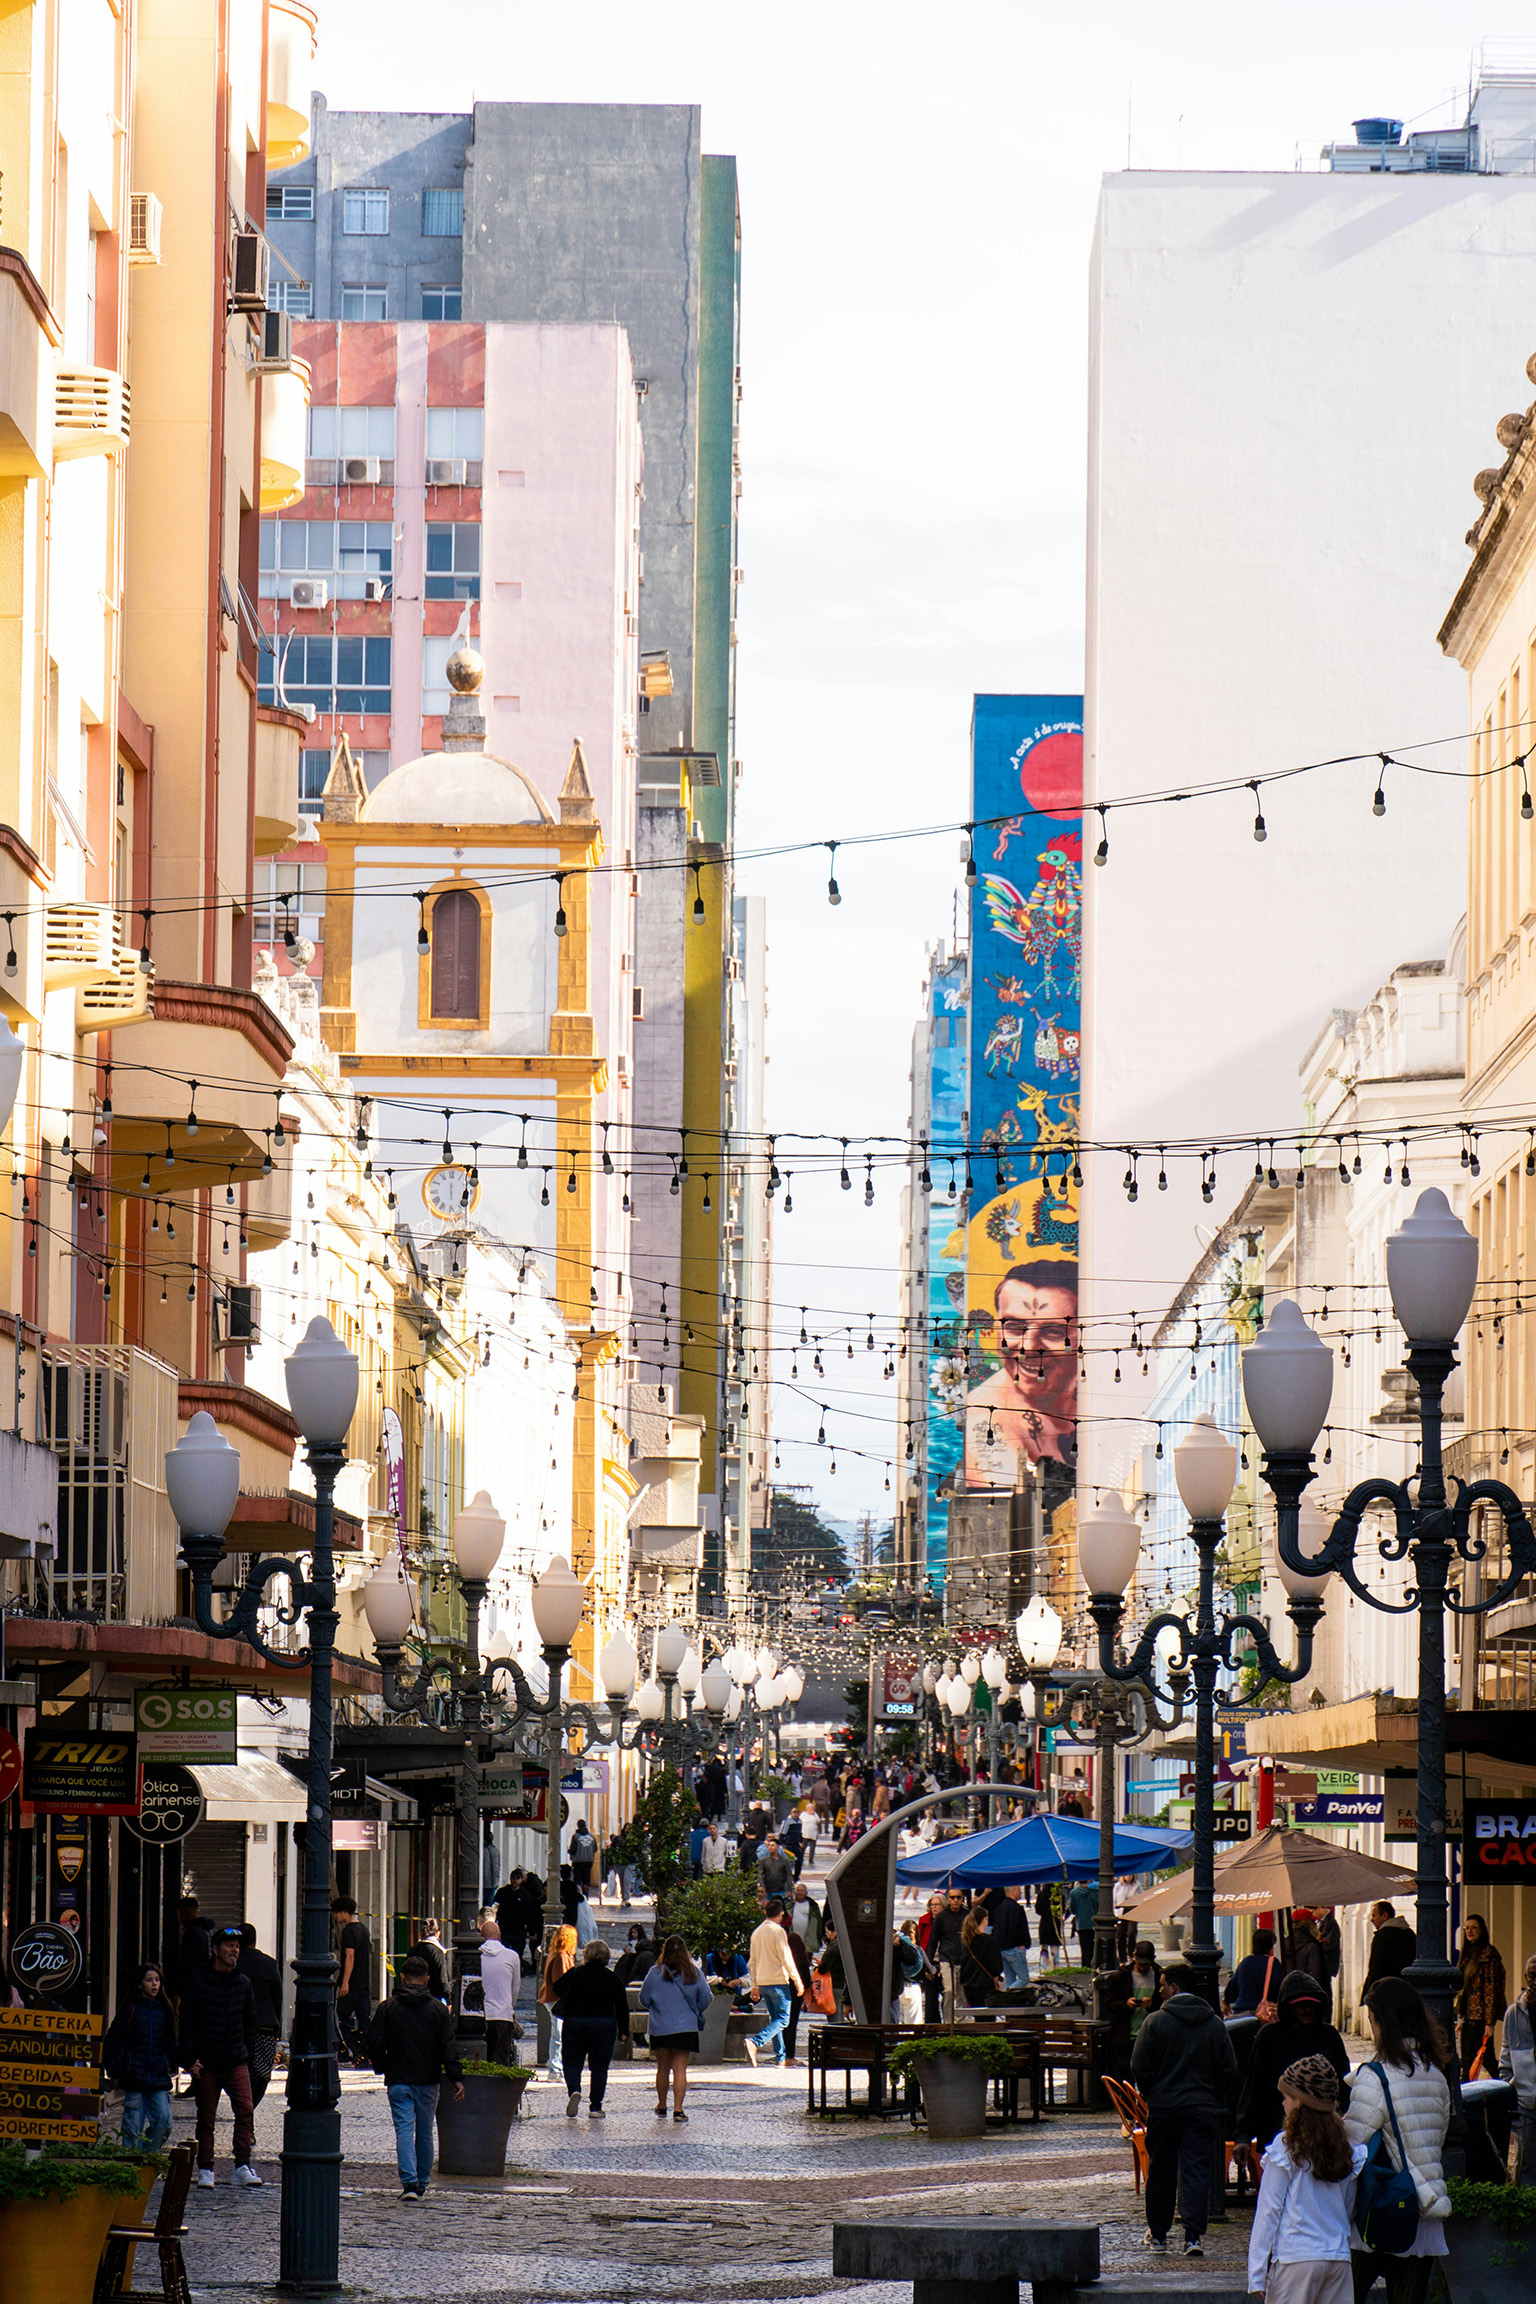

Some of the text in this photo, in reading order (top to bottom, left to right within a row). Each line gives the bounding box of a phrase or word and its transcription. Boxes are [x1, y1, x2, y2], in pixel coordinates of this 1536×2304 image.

[886, 1703, 914, 1714] 09:58
[32, 1742, 129, 1764] TRID
[38, 1777, 66, 1785] MARCA
[67, 1777, 84, 1786] QUE
[86, 1778, 108, 1787] VOCÊ
[143, 1779, 179, 1793] Ótica
[30, 1788, 64, 1796] MASCULINO
[1326, 1802, 1382, 1815] PanVel
[0, 2011, 92, 2031] CAFETERIA
[0, 2039, 93, 2060] SANDUICHES
[0, 2066, 73, 2084] BEBIDAS
[0, 2091, 63, 2111] BOLOS
[0, 2120, 98, 2139] SOBREMESAS
